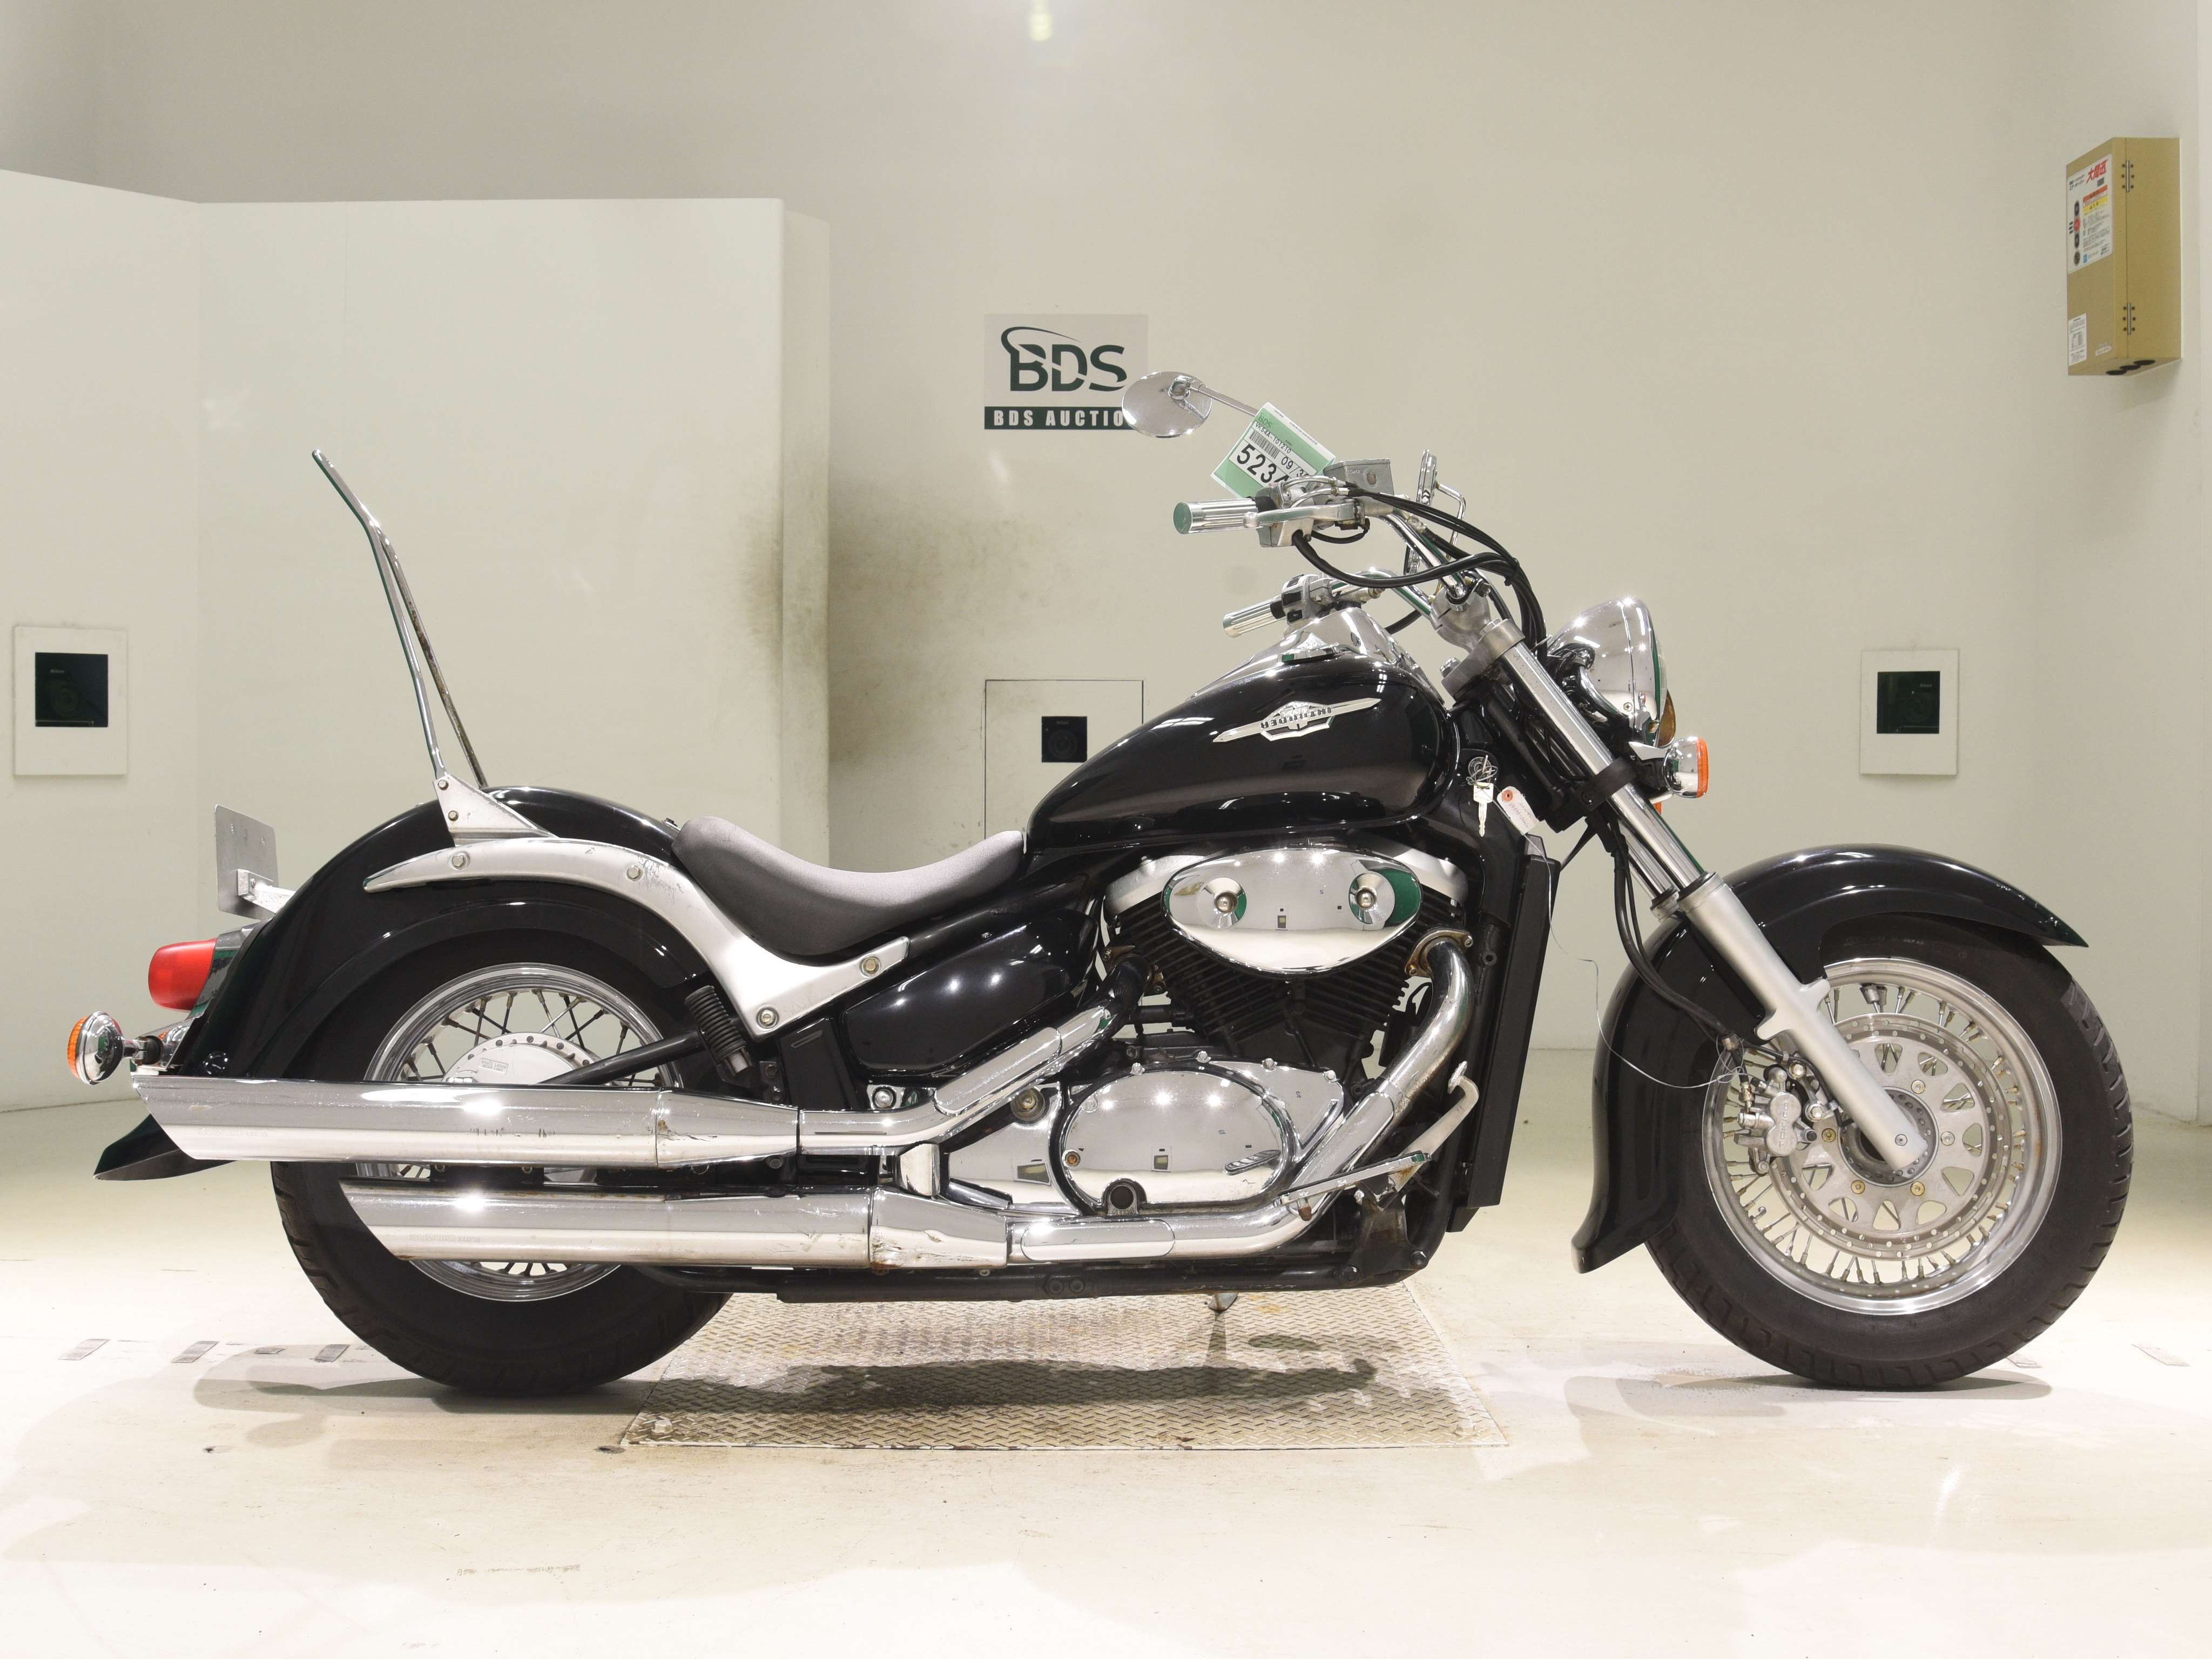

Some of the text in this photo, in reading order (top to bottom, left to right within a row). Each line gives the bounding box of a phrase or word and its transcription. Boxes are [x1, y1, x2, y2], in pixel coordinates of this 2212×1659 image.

[1001, 326, 1127, 392] BDS
[994, 410, 1123, 426] BDS AUCTIO
[1258, 413, 1273, 428] BDS
[409, 1233, 457, 1242] SUZUKI
